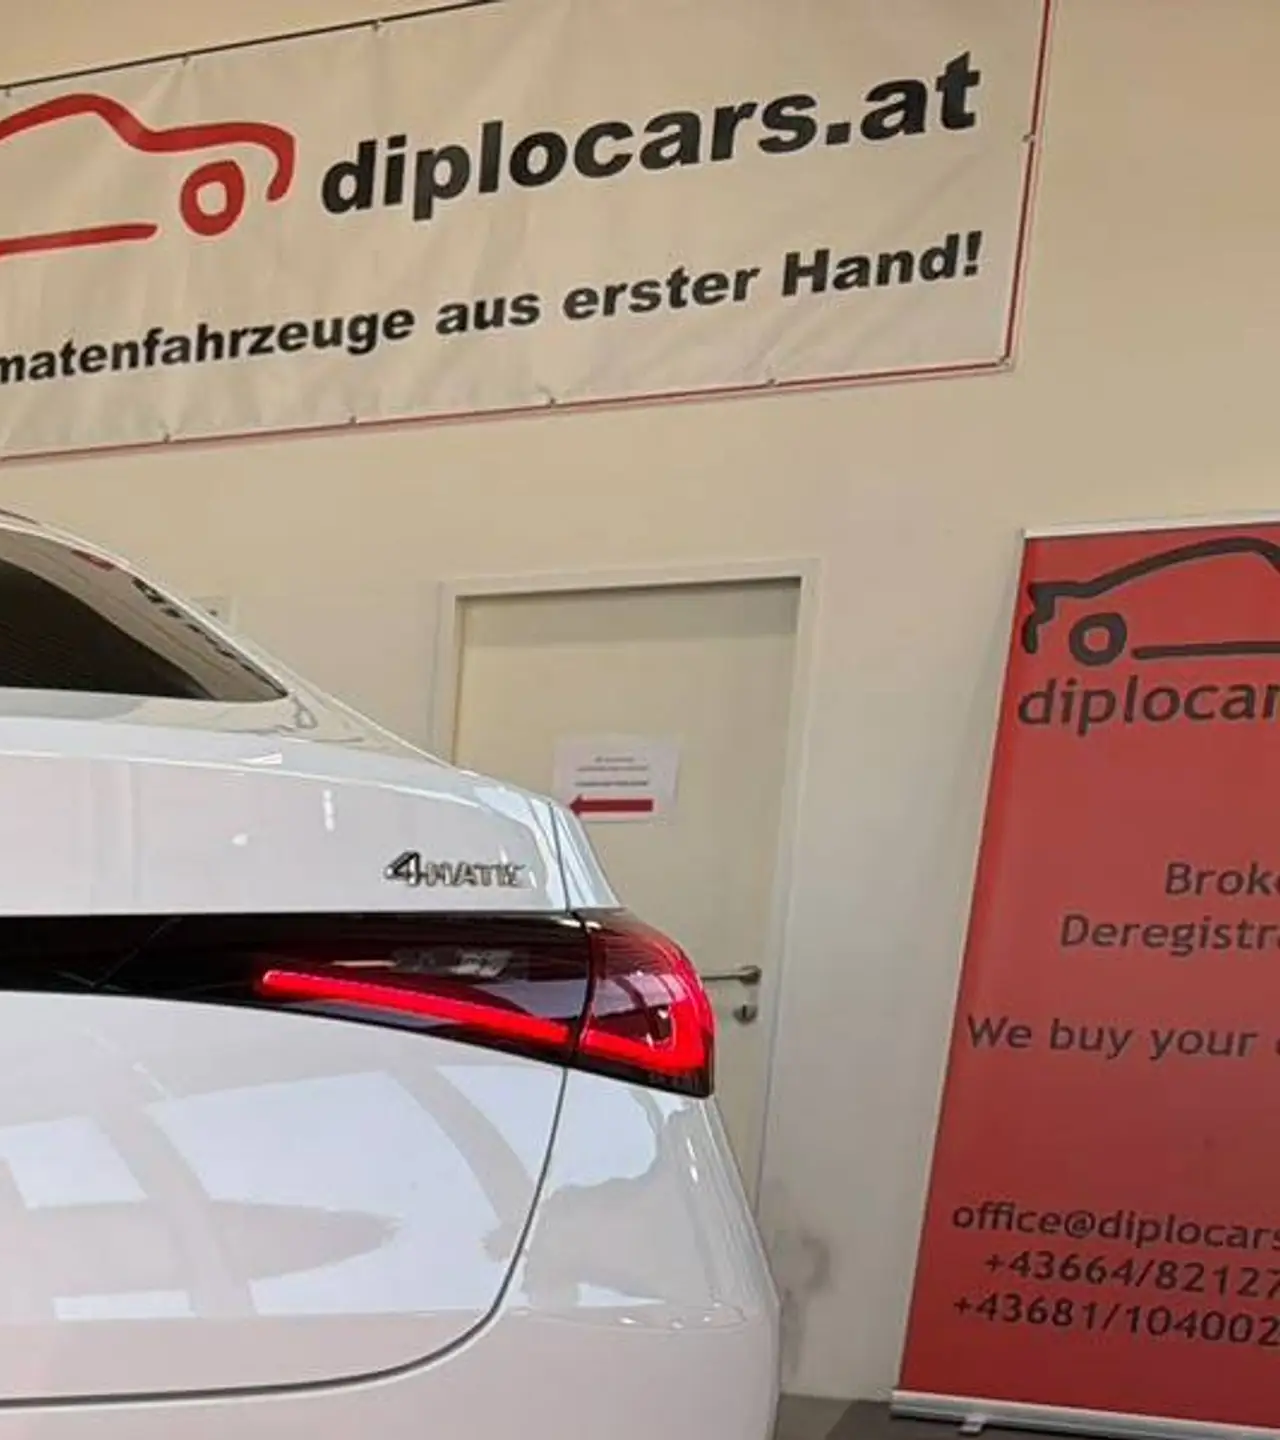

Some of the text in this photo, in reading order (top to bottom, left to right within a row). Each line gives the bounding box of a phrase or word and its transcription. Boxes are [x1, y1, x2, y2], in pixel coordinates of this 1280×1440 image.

[321, 51, 983, 220] diplocars.at
[435, 293, 541, 335] aus
[563, 266, 761, 320] erster
[781, 230, 983, 298] Hand!
[1164, 861, 1280, 897] Brok
[1060, 913, 1280, 957] Deregistr
[967, 1014, 1032, 1049] We
[1049, 1017, 1134, 1060] buy
[1148, 1028, 1259, 1061] your
[952, 1294, 1280, 1347] +43681/104002
